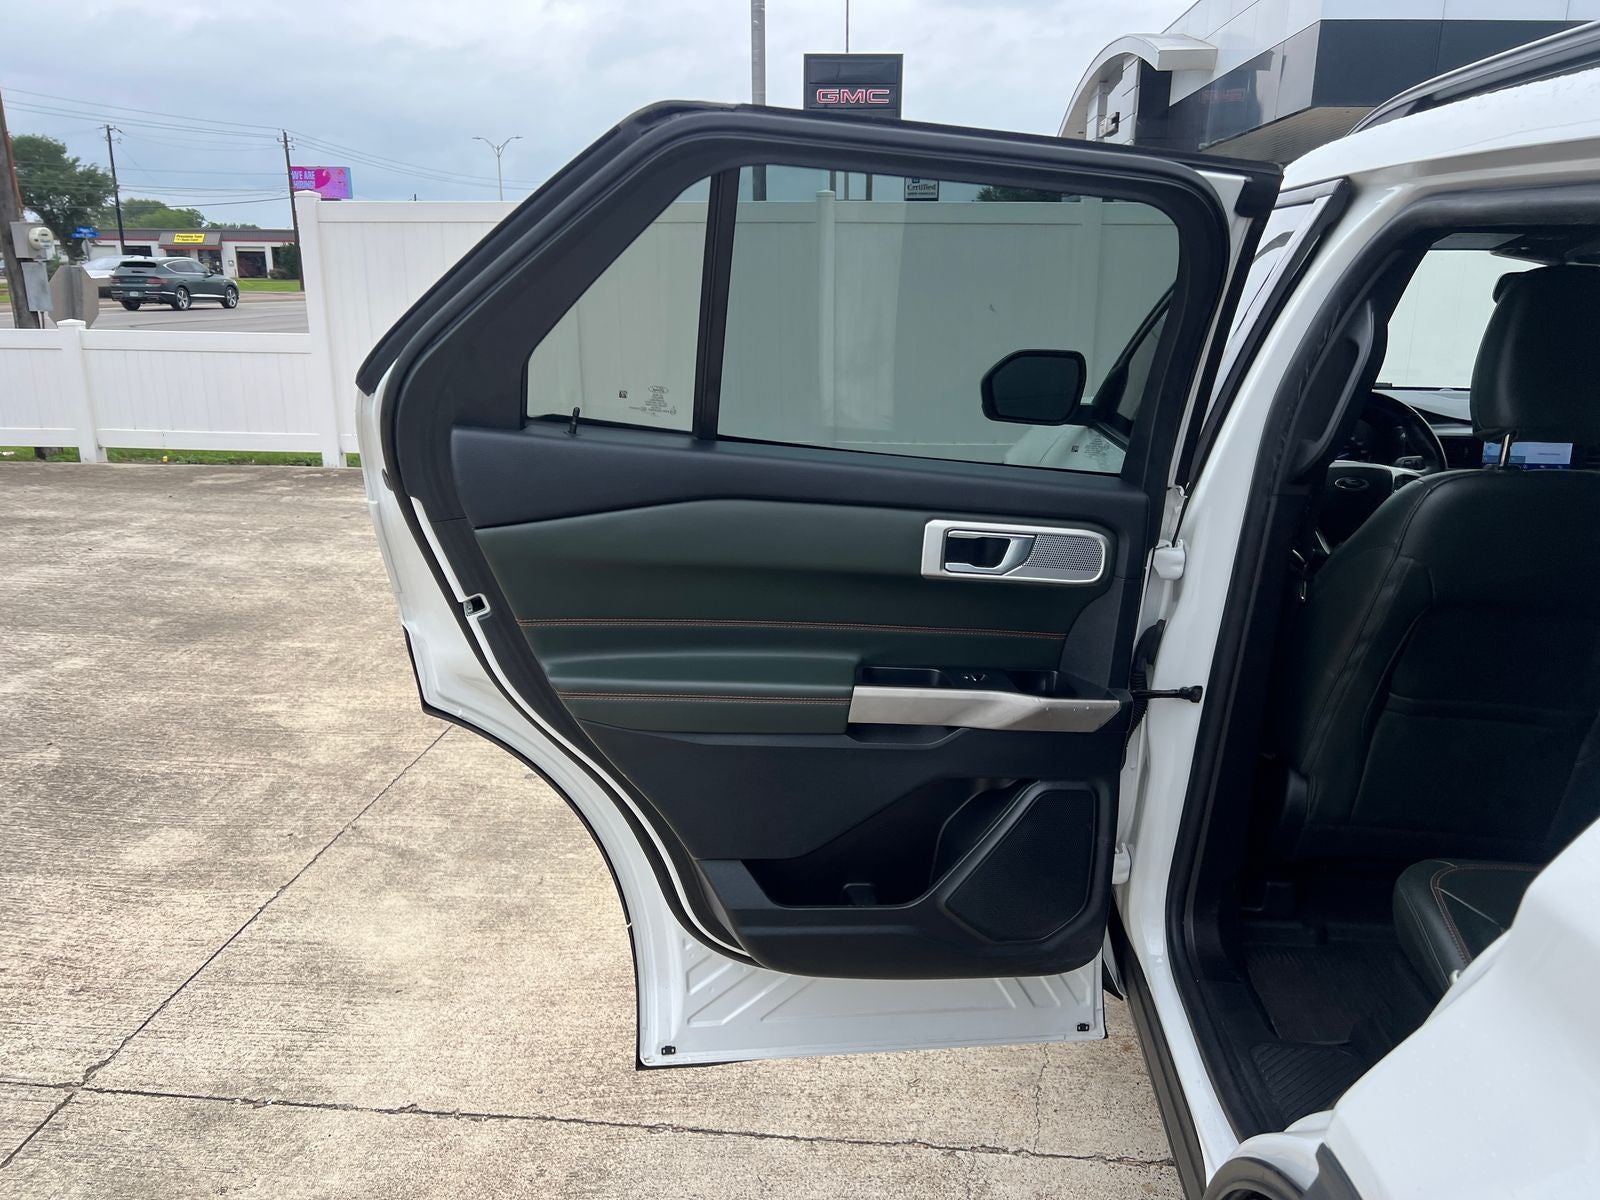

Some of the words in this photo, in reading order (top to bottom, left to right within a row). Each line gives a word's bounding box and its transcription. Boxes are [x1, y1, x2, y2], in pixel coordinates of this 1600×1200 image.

[817, 89, 890, 104] GMC
[291, 170, 304, 180] WE
[304, 170, 315, 180] ARE
[907, 183, 937, 191] Certified
